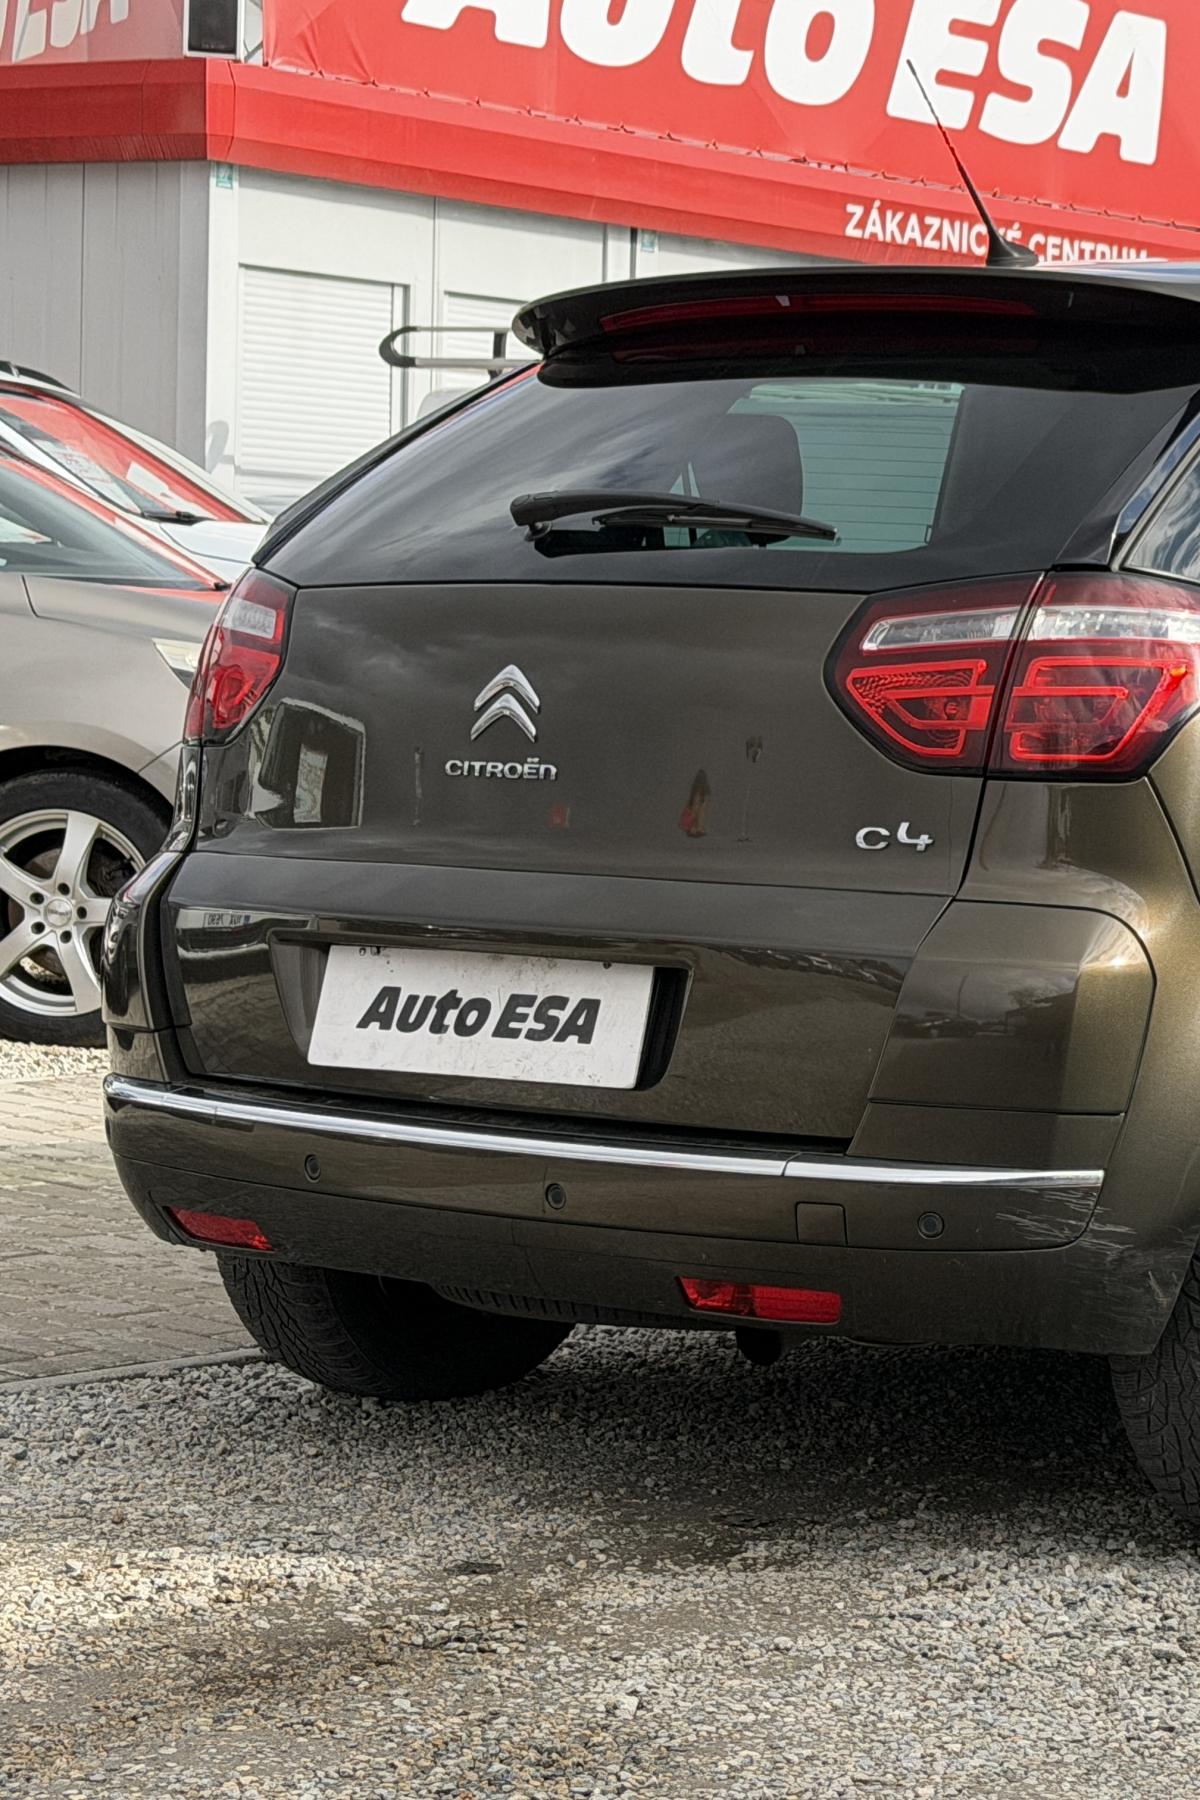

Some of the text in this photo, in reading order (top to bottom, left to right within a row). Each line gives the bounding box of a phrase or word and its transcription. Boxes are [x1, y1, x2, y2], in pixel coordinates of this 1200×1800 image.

[886, 0, 1168, 165] ESA
[845, 200, 1022, 256] ZÁKAZNICÉ
[855, 821, 934, 852] C4
[356, 986, 601, 1045] Auto ESA
